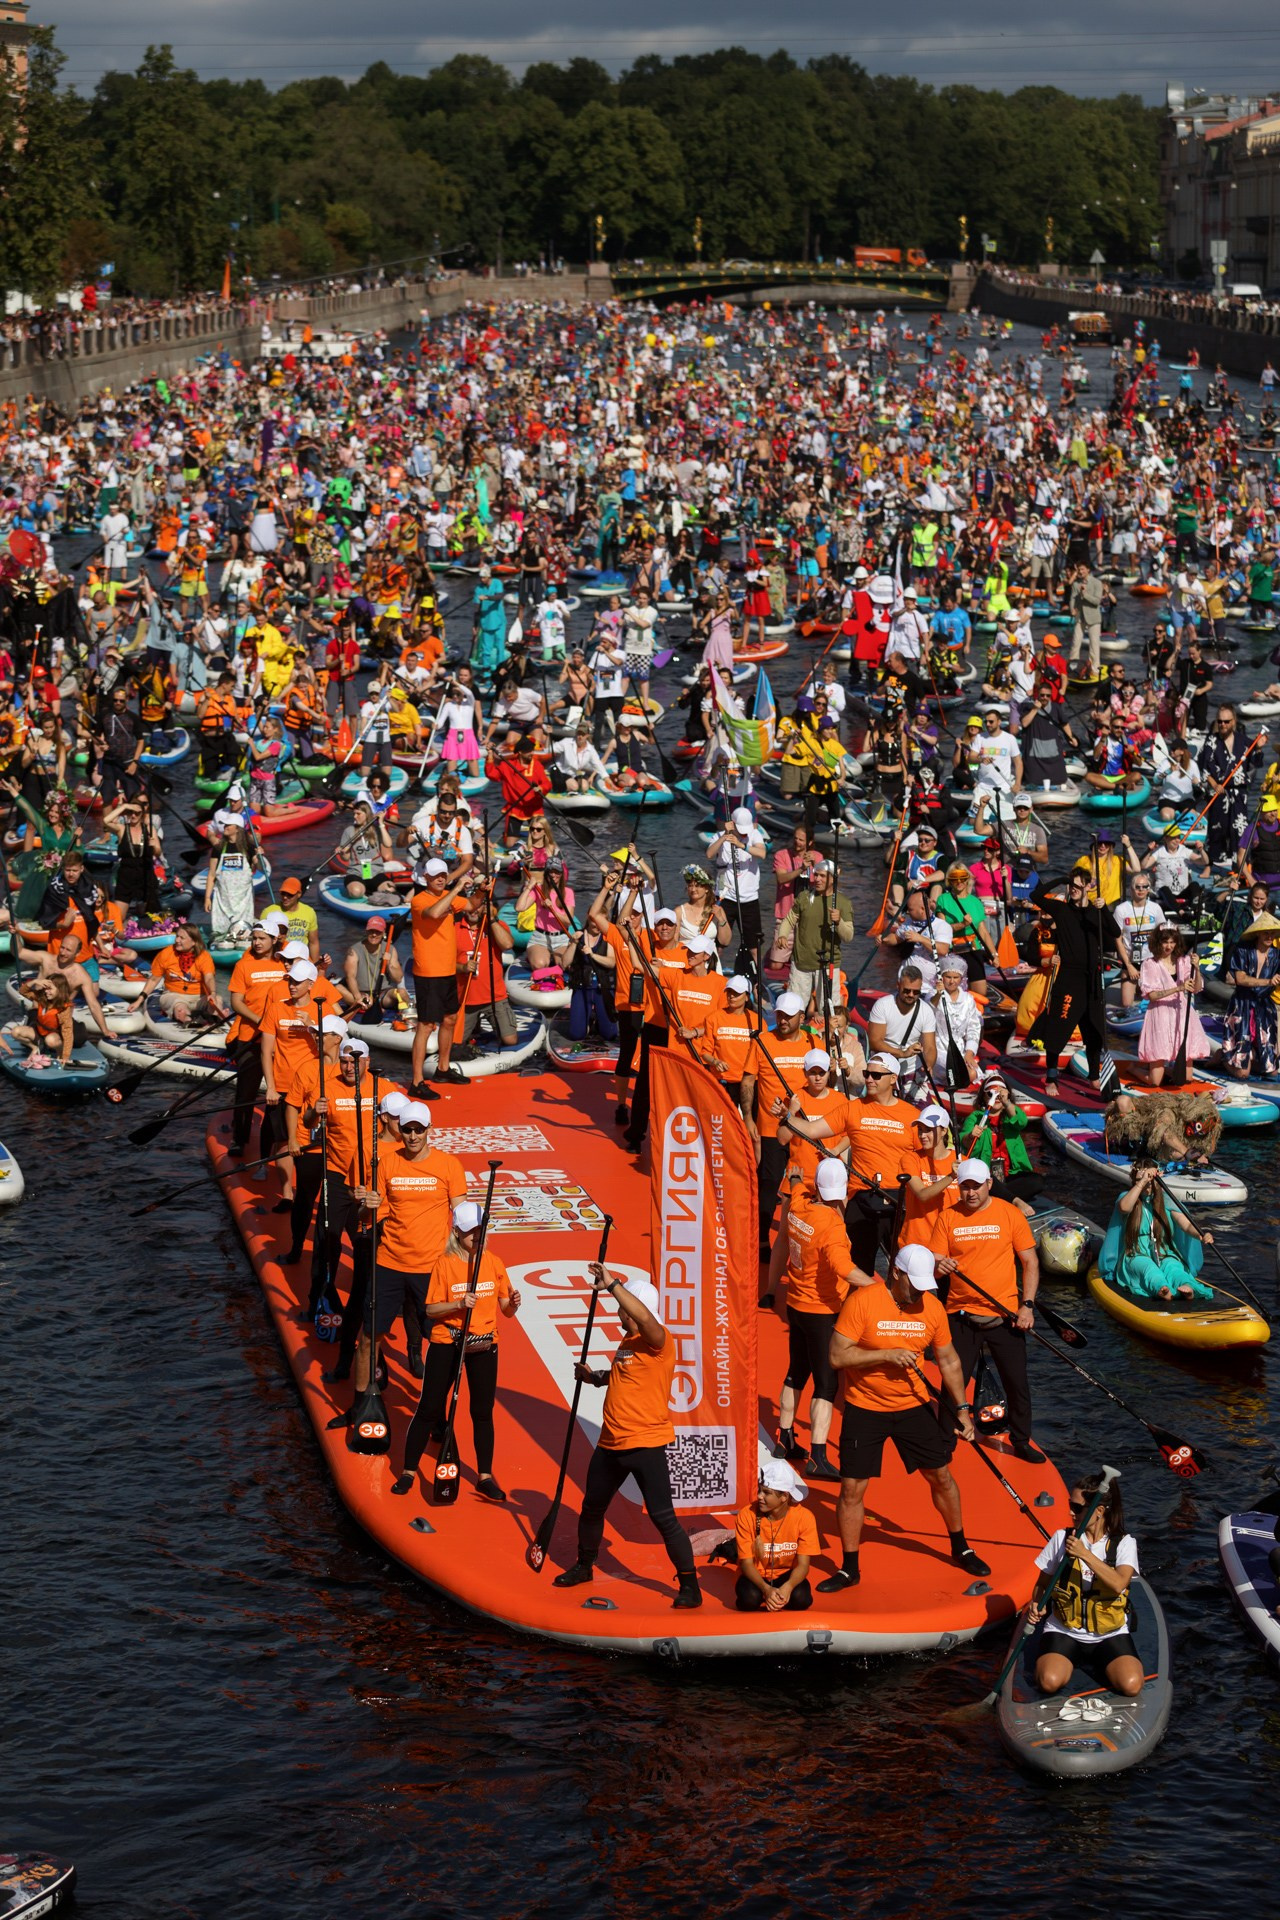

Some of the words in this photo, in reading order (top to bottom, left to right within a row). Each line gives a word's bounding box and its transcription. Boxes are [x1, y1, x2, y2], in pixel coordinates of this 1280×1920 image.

[711, 1114, 725, 1222] ЭНЕРГЕТИКЕ
[392, 1177, 432, 1185] ЭНЕРГИЯ
[716, 1226, 727, 1249] ОБ
[954, 1226, 994, 1235] ЭНЕРГИЯ
[665, 1151, 698, 1406] ЭНЕРГИЯ
[713, 1254, 731, 1407] ОНЛАЙН-ЖУРНАЛ
[878, 1321, 919, 1329] ЭНЕРГИЯ
[877, 1330, 925, 1338] онлайн-журнал
